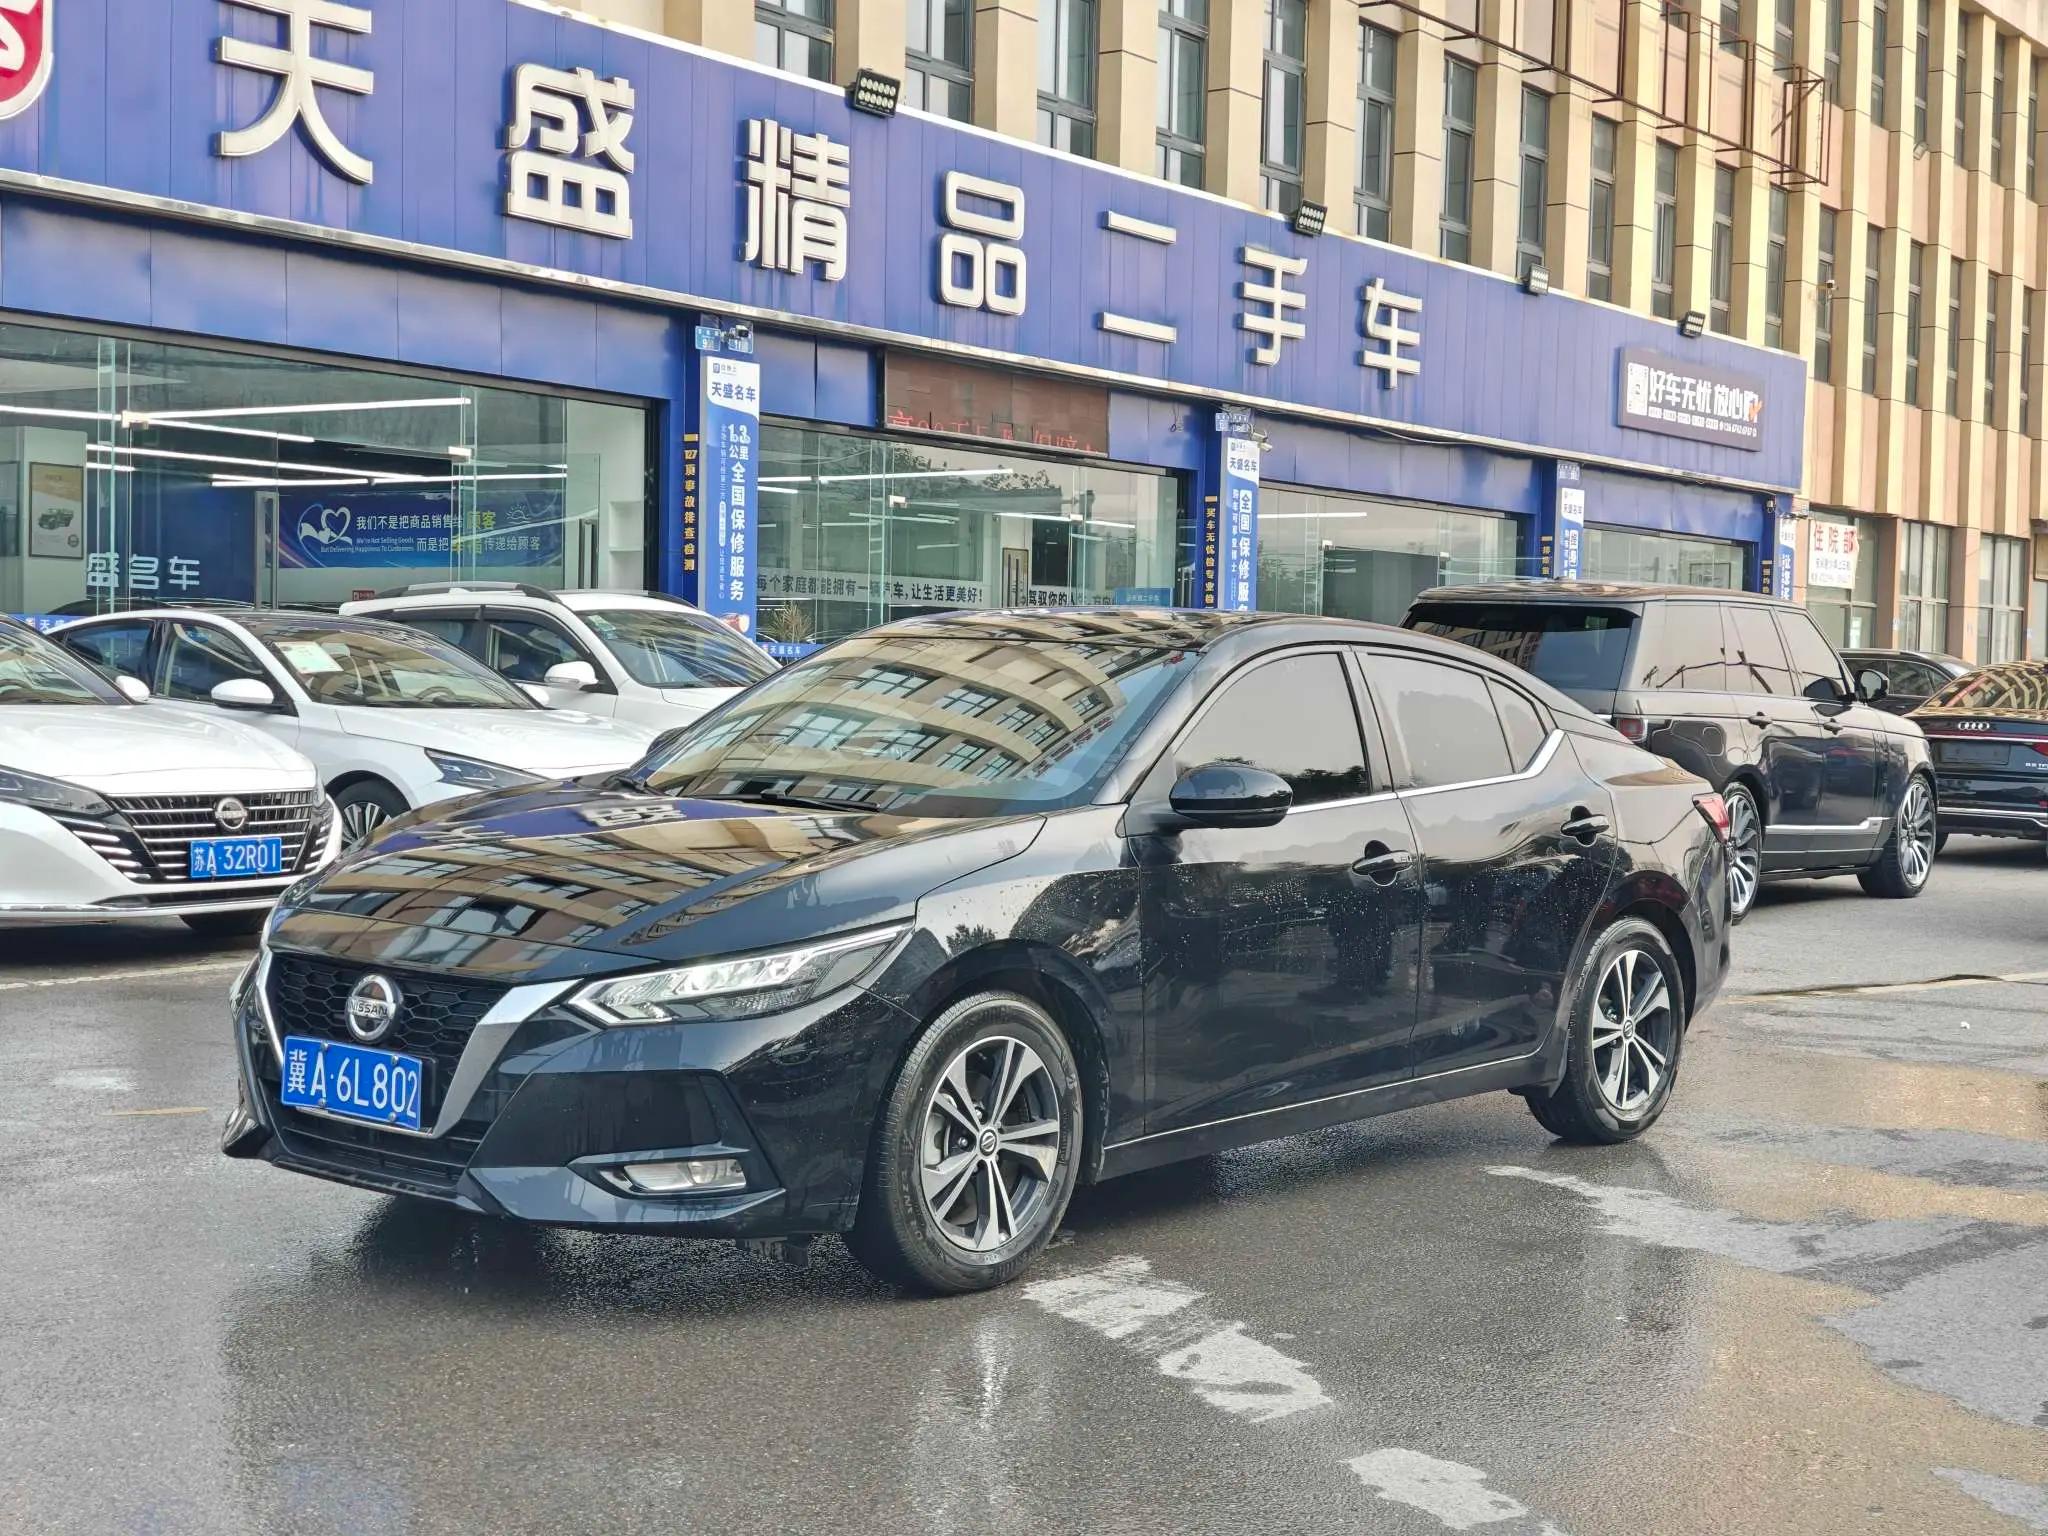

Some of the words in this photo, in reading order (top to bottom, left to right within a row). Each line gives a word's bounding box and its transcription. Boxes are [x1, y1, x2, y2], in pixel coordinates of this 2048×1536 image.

[216, 0, 1423, 389] 天盛精品二手车
[711, 381, 757, 403] 天盛名车
[1229, 456, 1257, 472] 天盛名车
[1813, 524, 1856, 554] 住院部
[87, 552, 200, 591] 盛名车
[348, 997, 389, 1019] NISSAN
